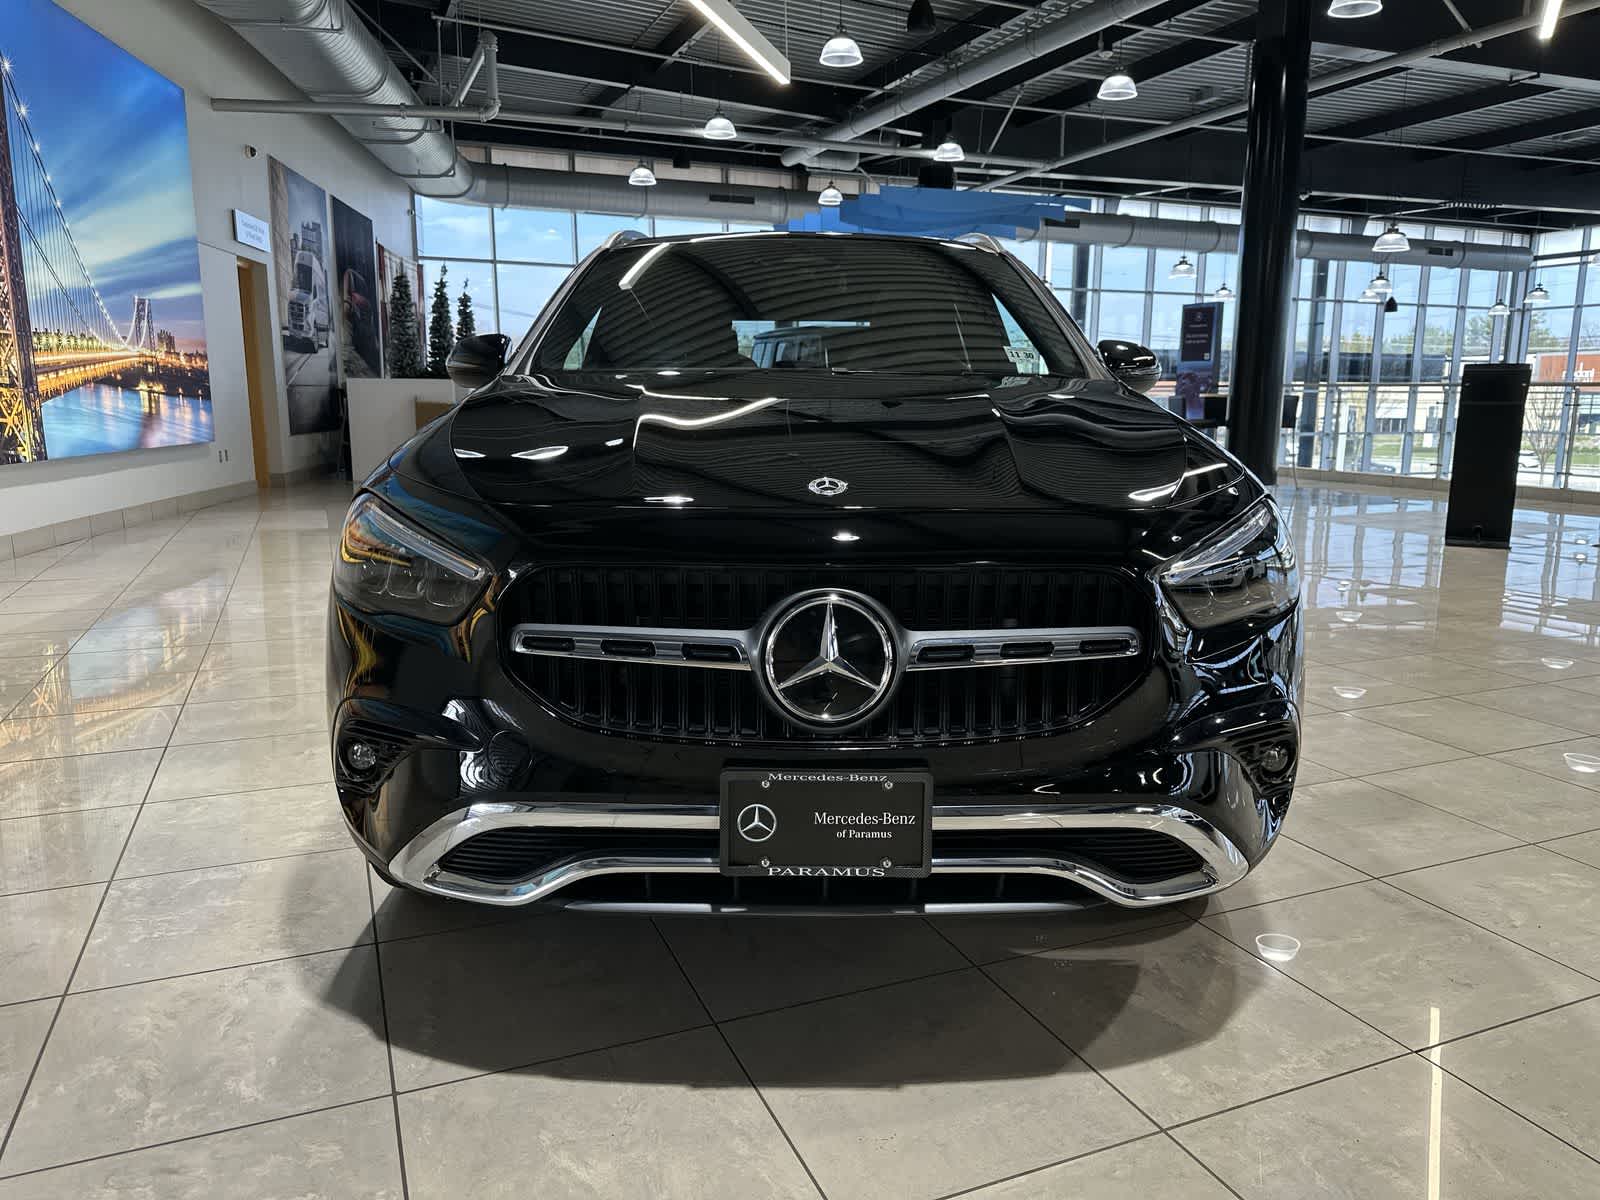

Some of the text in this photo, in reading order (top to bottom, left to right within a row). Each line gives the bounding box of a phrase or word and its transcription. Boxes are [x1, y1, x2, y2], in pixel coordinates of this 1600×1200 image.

[768, 773, 888, 782] Mercedes-Benz
[814, 811, 916, 825] Mercedes-Benz
[836, 829, 893, 839] of Paramus
[767, 866, 886, 877] PARAMUS
